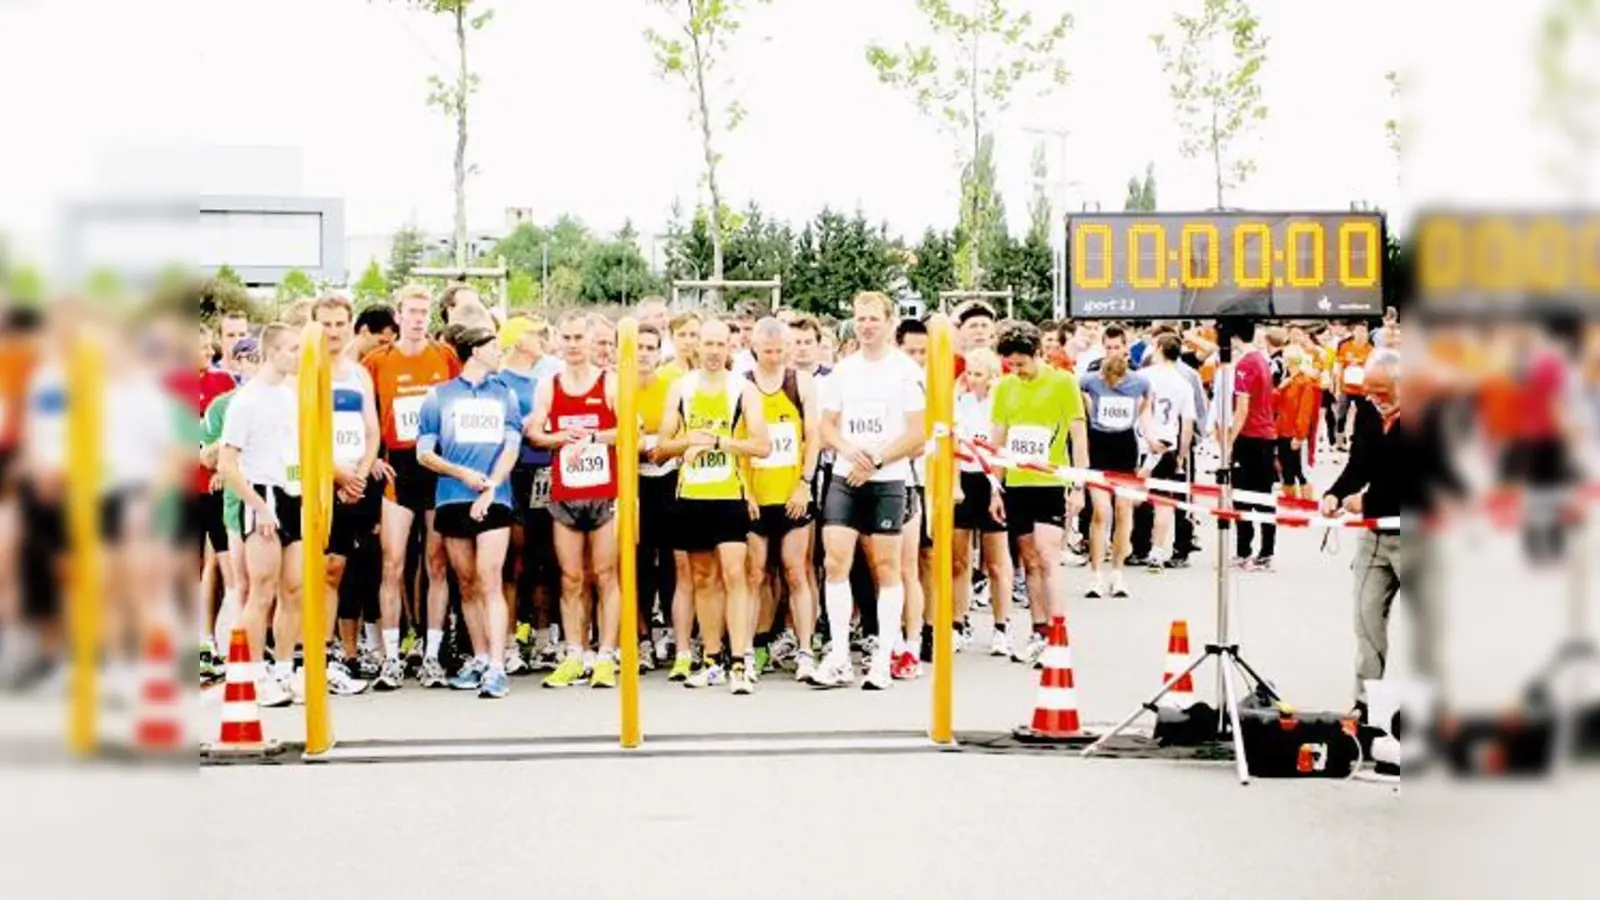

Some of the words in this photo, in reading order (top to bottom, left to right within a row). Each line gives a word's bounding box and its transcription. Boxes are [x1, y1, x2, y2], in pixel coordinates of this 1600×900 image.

[1074, 221, 1377, 289] 00:00:00
[848, 419, 882, 435] 1045
[336, 429, 361, 447] 075
[1011, 439, 1046, 455] 8834
